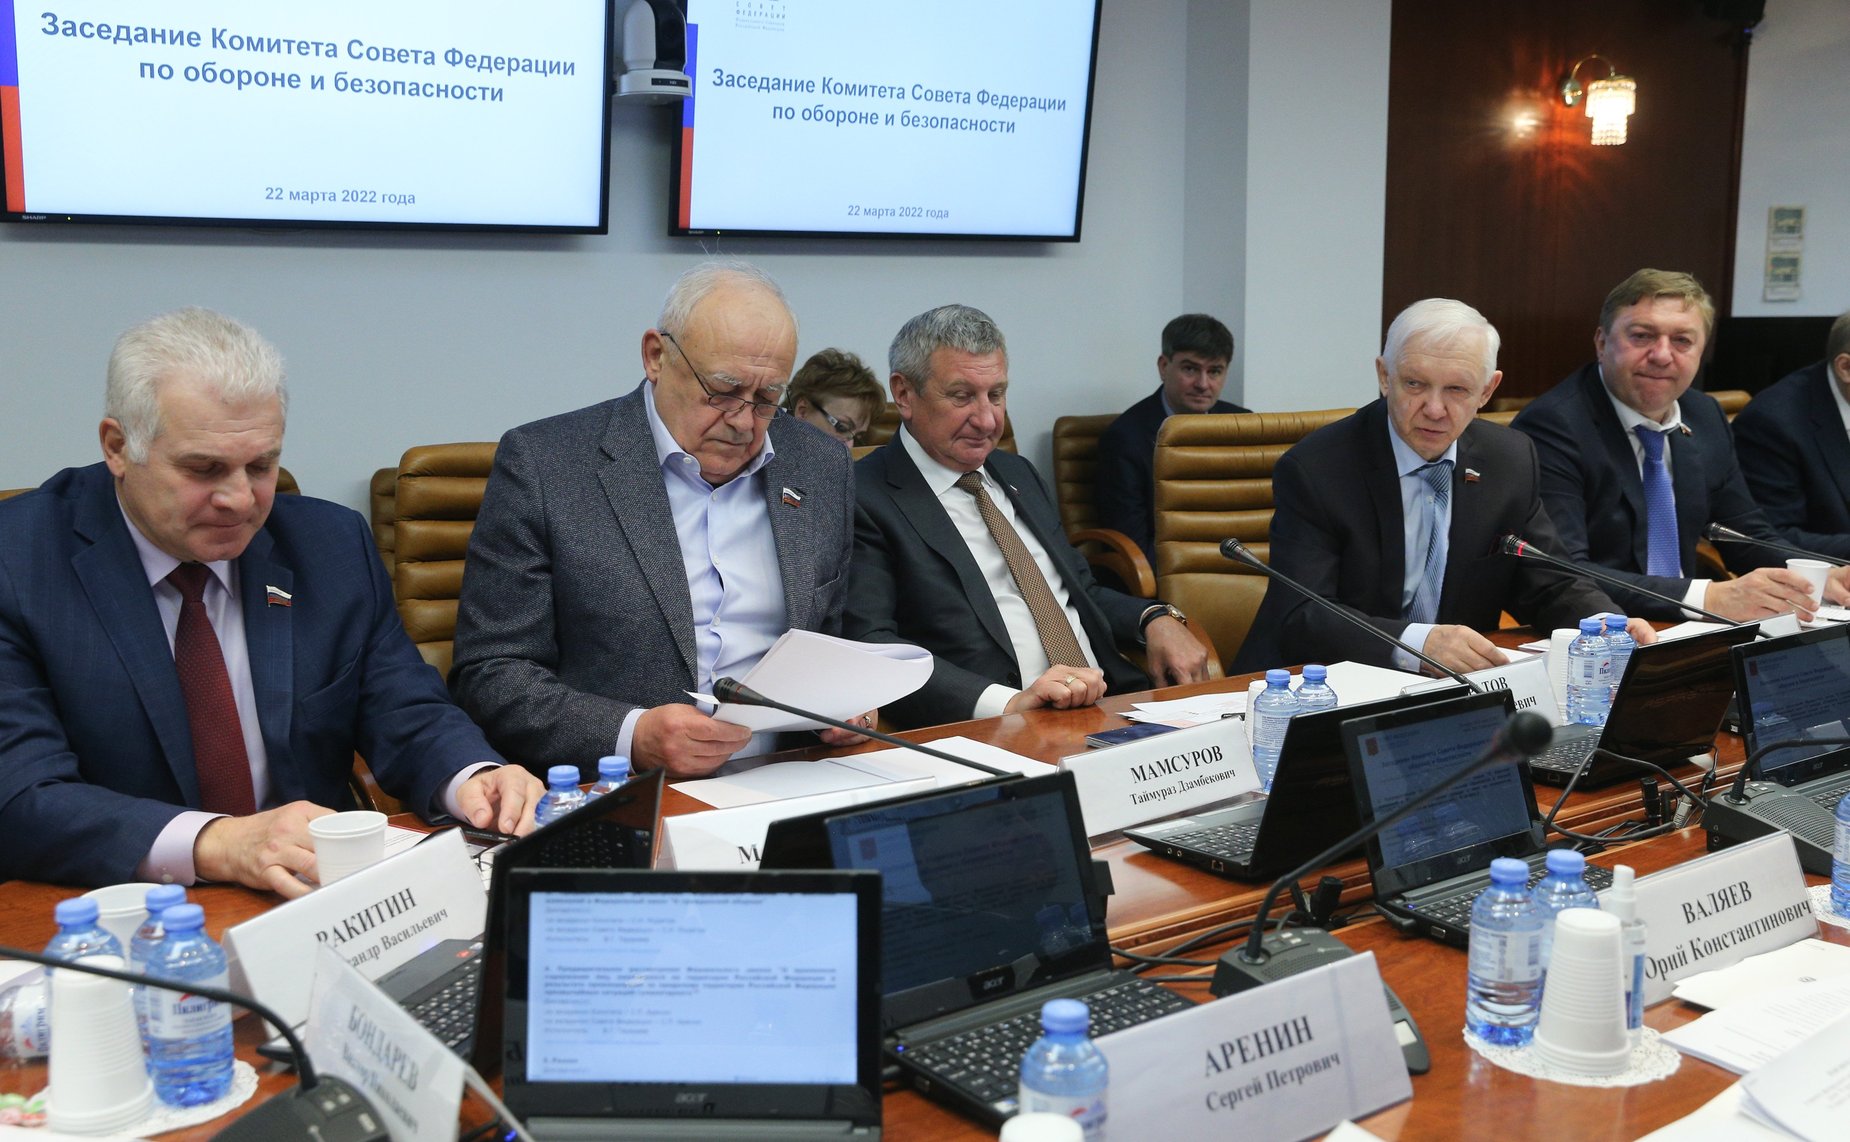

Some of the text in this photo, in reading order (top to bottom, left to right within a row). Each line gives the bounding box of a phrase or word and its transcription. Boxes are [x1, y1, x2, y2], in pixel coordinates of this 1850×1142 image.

[41, 12, 574, 77] Заседание Комитета Совета Федерации
[140, 62, 503, 101] по обороне и безопасности
[713, 69, 1066, 112] Заседание Комитета Совета Федерации
[773, 104, 1015, 133] по обороне и безопасности
[266, 187, 415, 205] 22 марта 2022 года
[848, 205, 949, 219] 22 марта 2022 года
[1130, 746, 1223, 784] МАМСУРОВ
[1129, 769, 1236, 805] Таймураз Дзамбекович
[1682, 880, 1752, 924] ВАЛЯЕВ
[381, 909, 448, 951] Васильевич
[1689, 900, 1812, 962] Константинович
[348, 1005, 419, 1091] БОНДАРЕВ
[1205, 1015, 1313, 1078] АРЕНИН
[1206, 1052, 1341, 1112] Сергей Петрович
